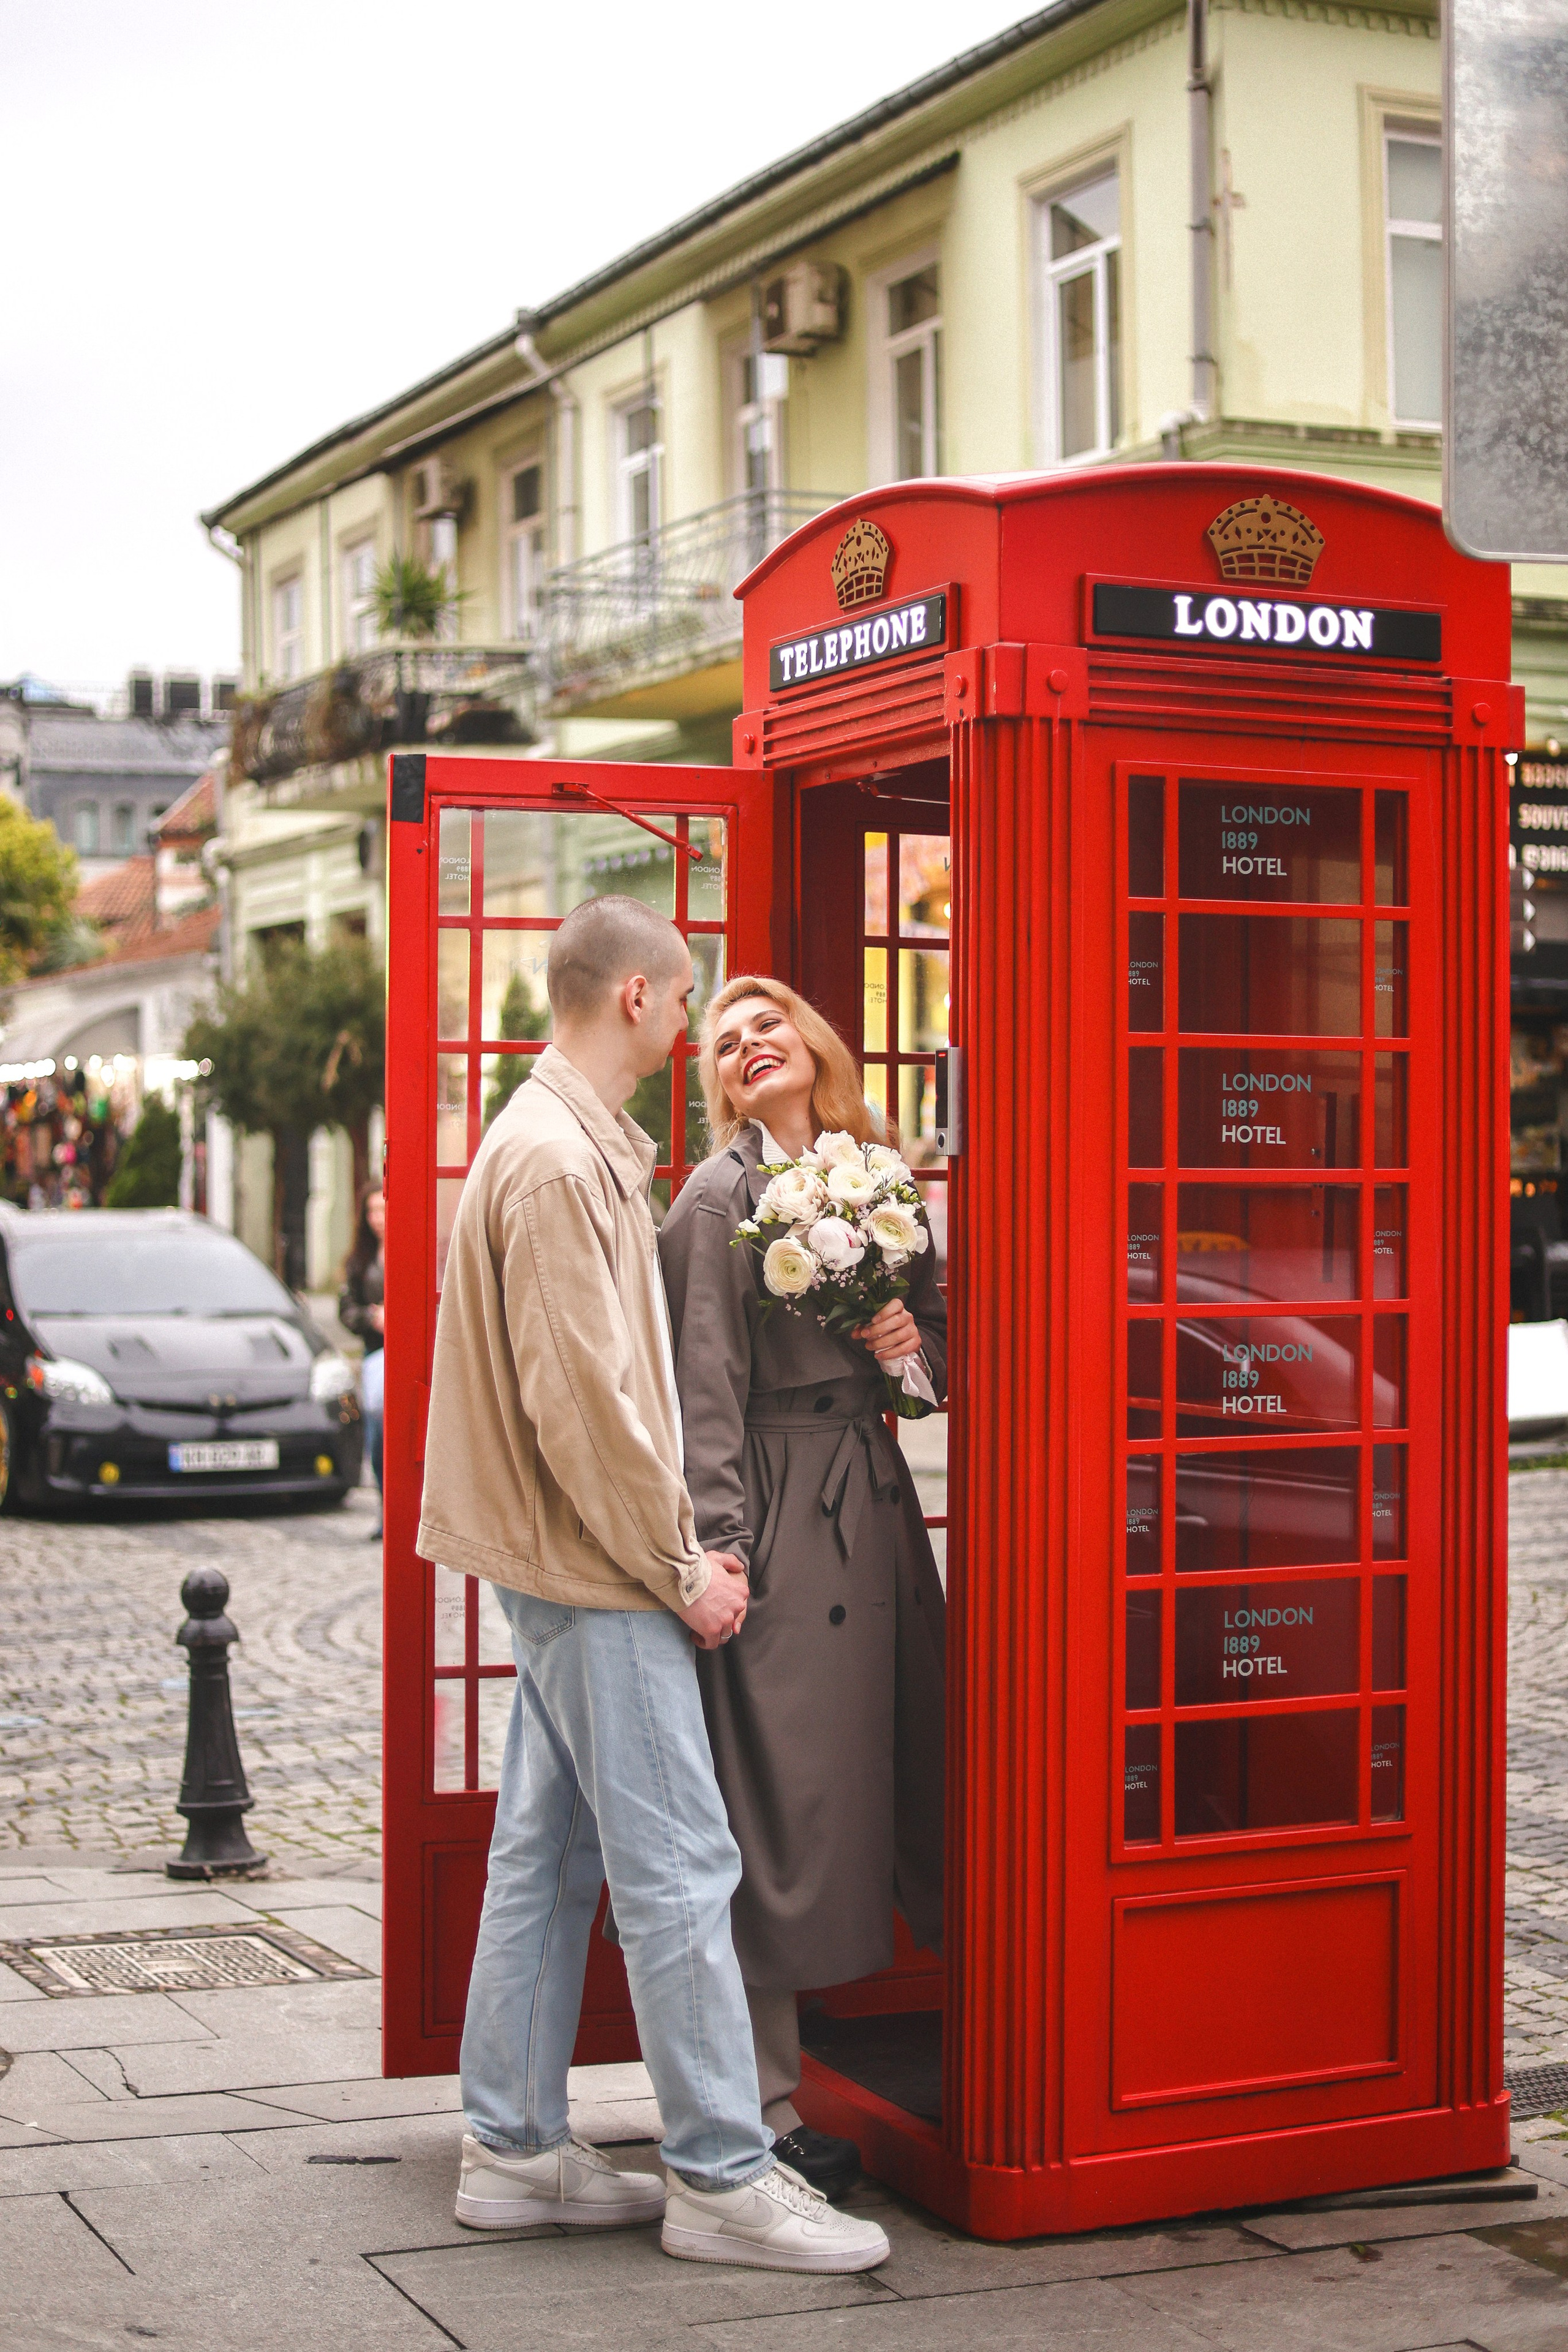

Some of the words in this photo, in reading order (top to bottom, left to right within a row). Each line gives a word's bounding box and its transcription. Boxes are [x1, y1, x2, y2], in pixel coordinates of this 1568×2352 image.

[1173, 595, 1374, 649] LONDON
[780, 605, 927, 681] TELEPHONE
[1222, 805, 1310, 826] LONDON
[1222, 831, 1258, 850] 1889
[1223, 856, 1287, 876] HOTEL
[1223, 1073, 1311, 1093] LONDON
[1223, 1099, 1259, 1118] 1889
[1222, 1125, 1286, 1144] HOTEL
[1223, 1344, 1313, 1362] LONDON
[1223, 1370, 1259, 1388] 1889
[1223, 1395, 1287, 1414] HOTEL
[1224, 1607, 1313, 1628] LONDON
[1224, 1635, 1260, 1654] 1889
[1223, 1656, 1287, 1678] HOTEL
[1125, 1765, 1158, 1773] LONDON
[1125, 1781, 1148, 1790] HOTEL
